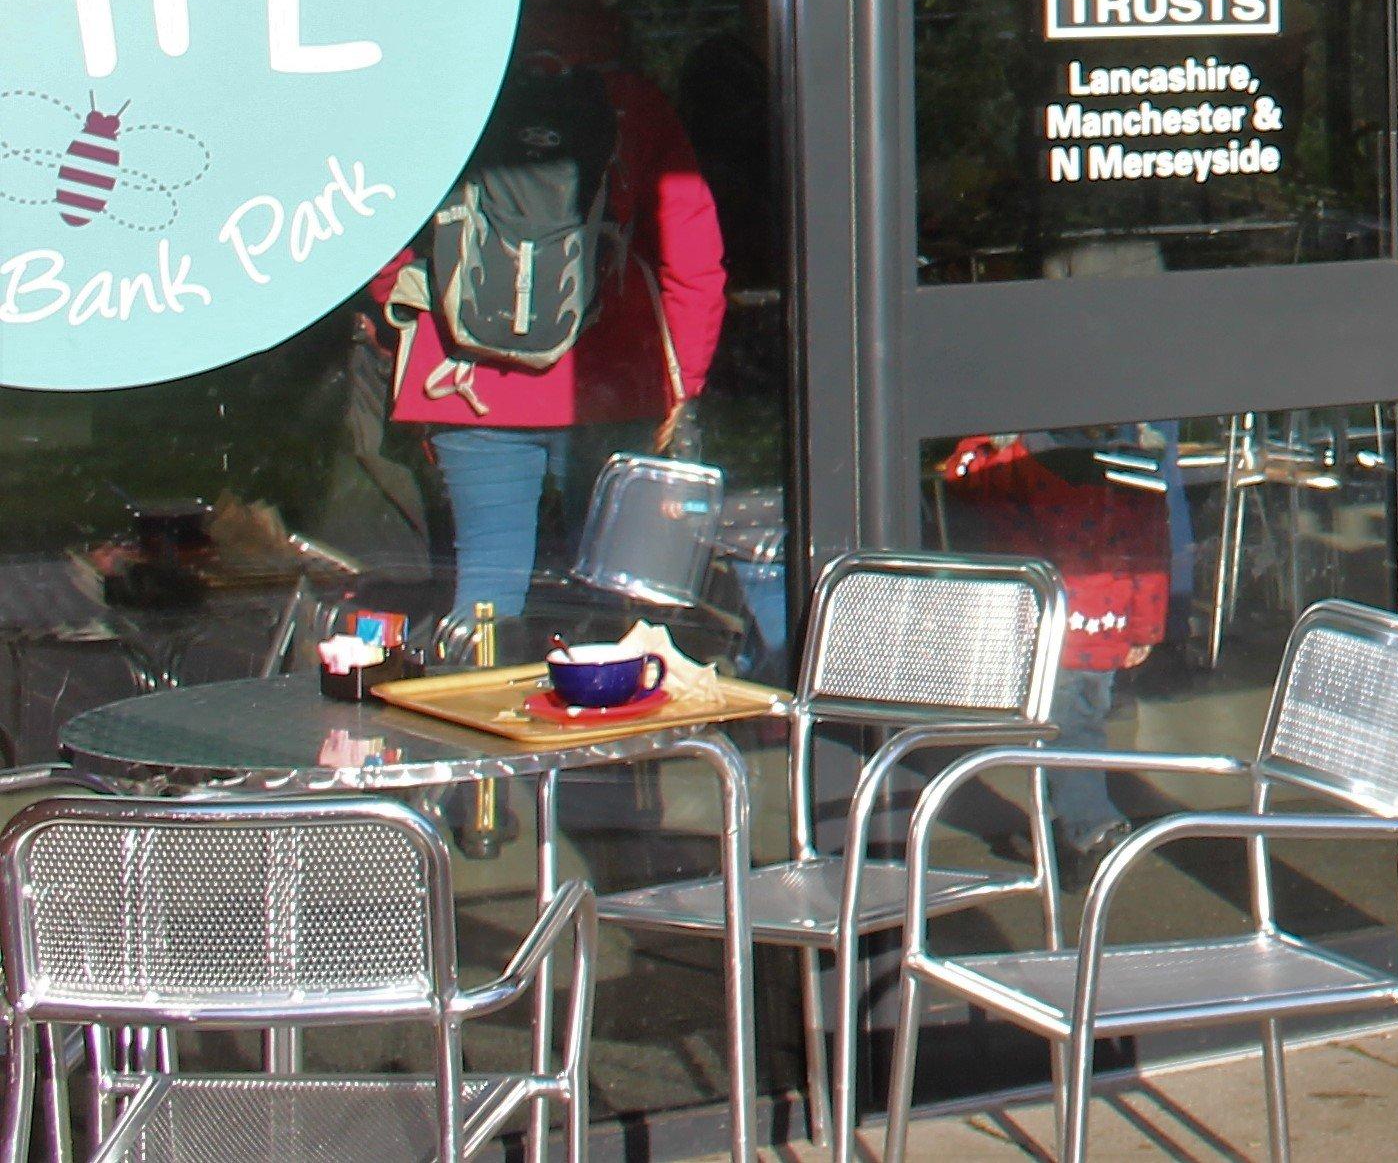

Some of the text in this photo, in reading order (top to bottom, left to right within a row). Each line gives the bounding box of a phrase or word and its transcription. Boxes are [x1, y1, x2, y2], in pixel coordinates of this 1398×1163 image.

[1068, 57, 1260, 97] Lancashire,
[1046, 97, 1282, 140] Manchester &
[1050, 139, 1281, 183] N Merseyside
[0, 155, 396, 326] Bank Park
